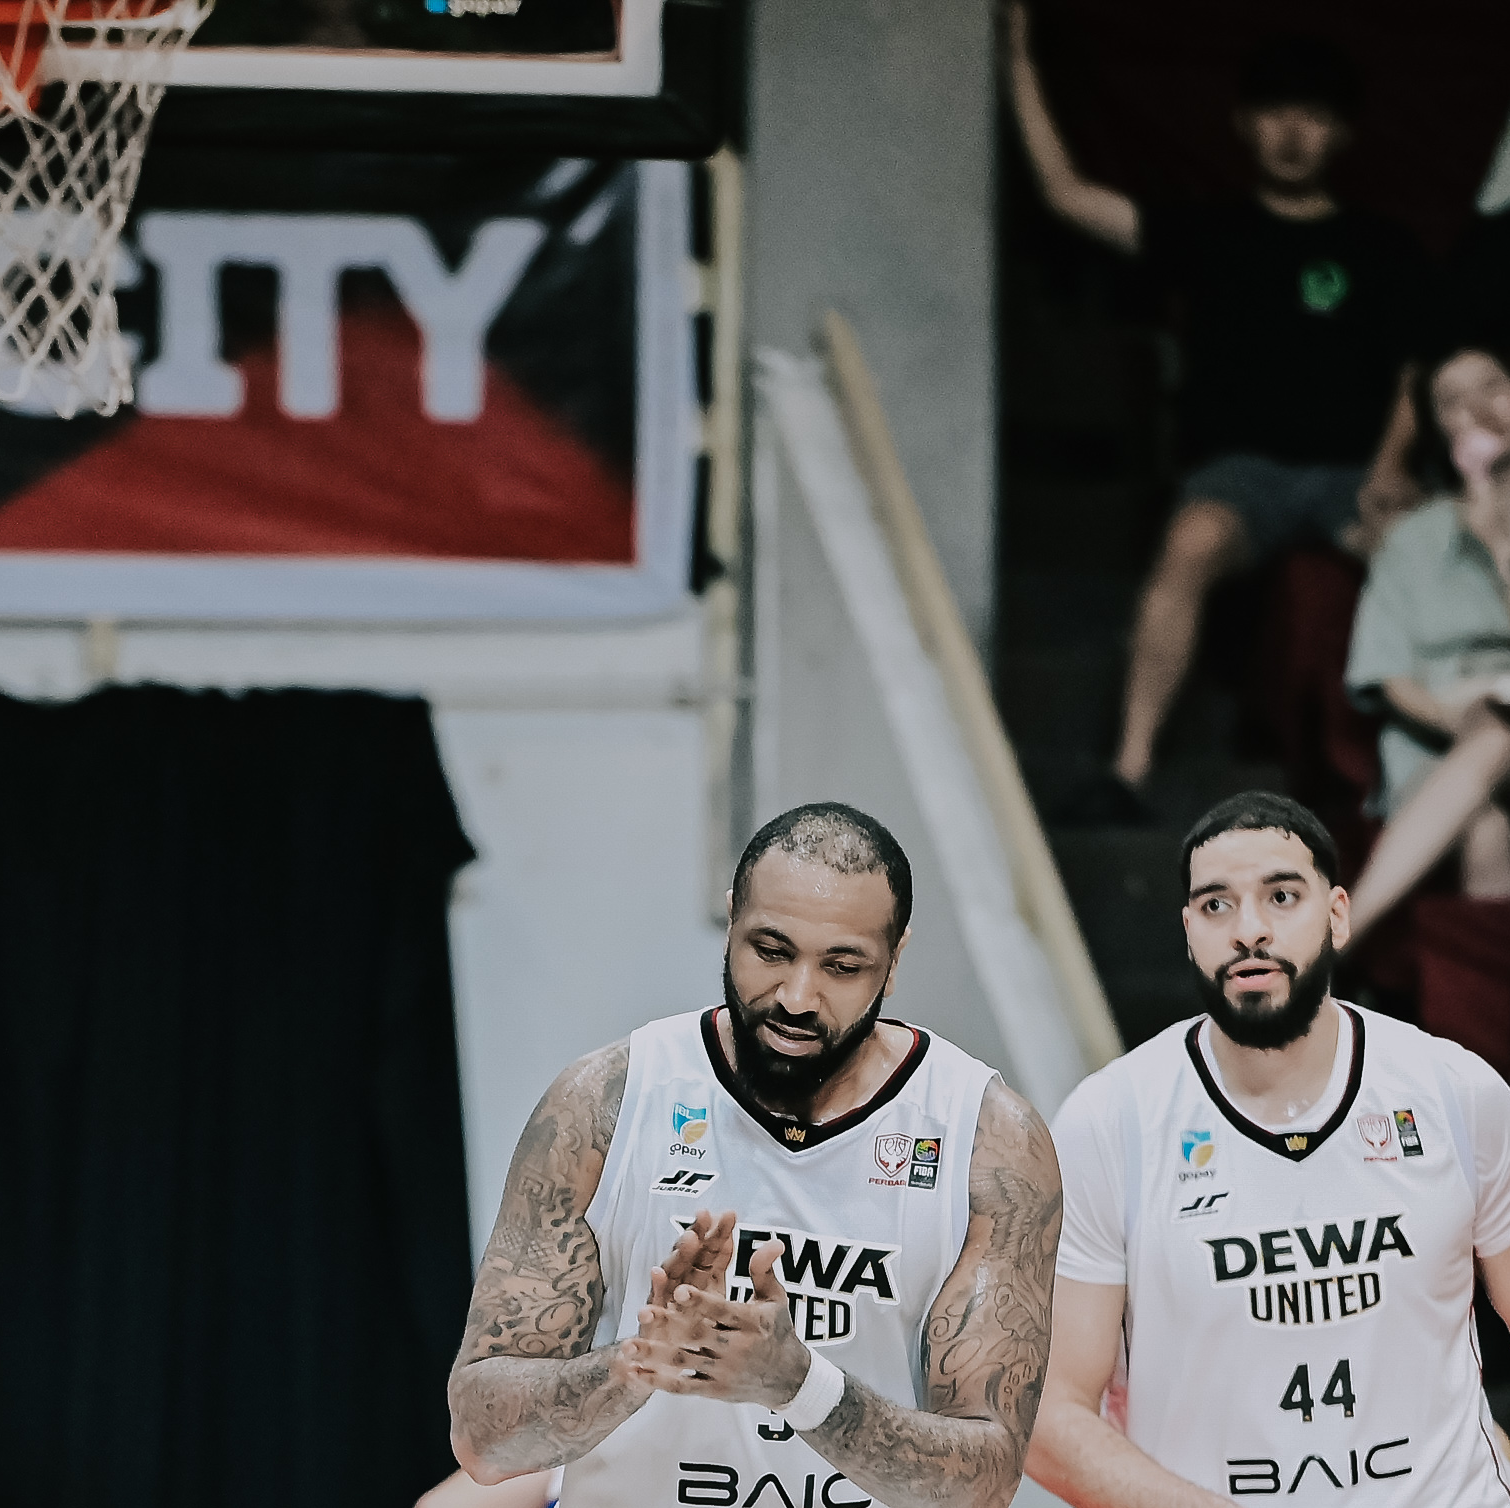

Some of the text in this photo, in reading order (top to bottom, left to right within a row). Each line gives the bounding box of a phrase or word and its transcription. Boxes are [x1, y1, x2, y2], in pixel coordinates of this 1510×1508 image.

[669, 1143, 707, 1160] gopay
[675, 1220, 896, 1300] EWA
[1203, 1214, 1416, 1282] DEWA
[1248, 1272, 1382, 1325] UNITED
[1279, 1358, 1356, 1423] 44
[1226, 1436, 1413, 1495] BAIC
